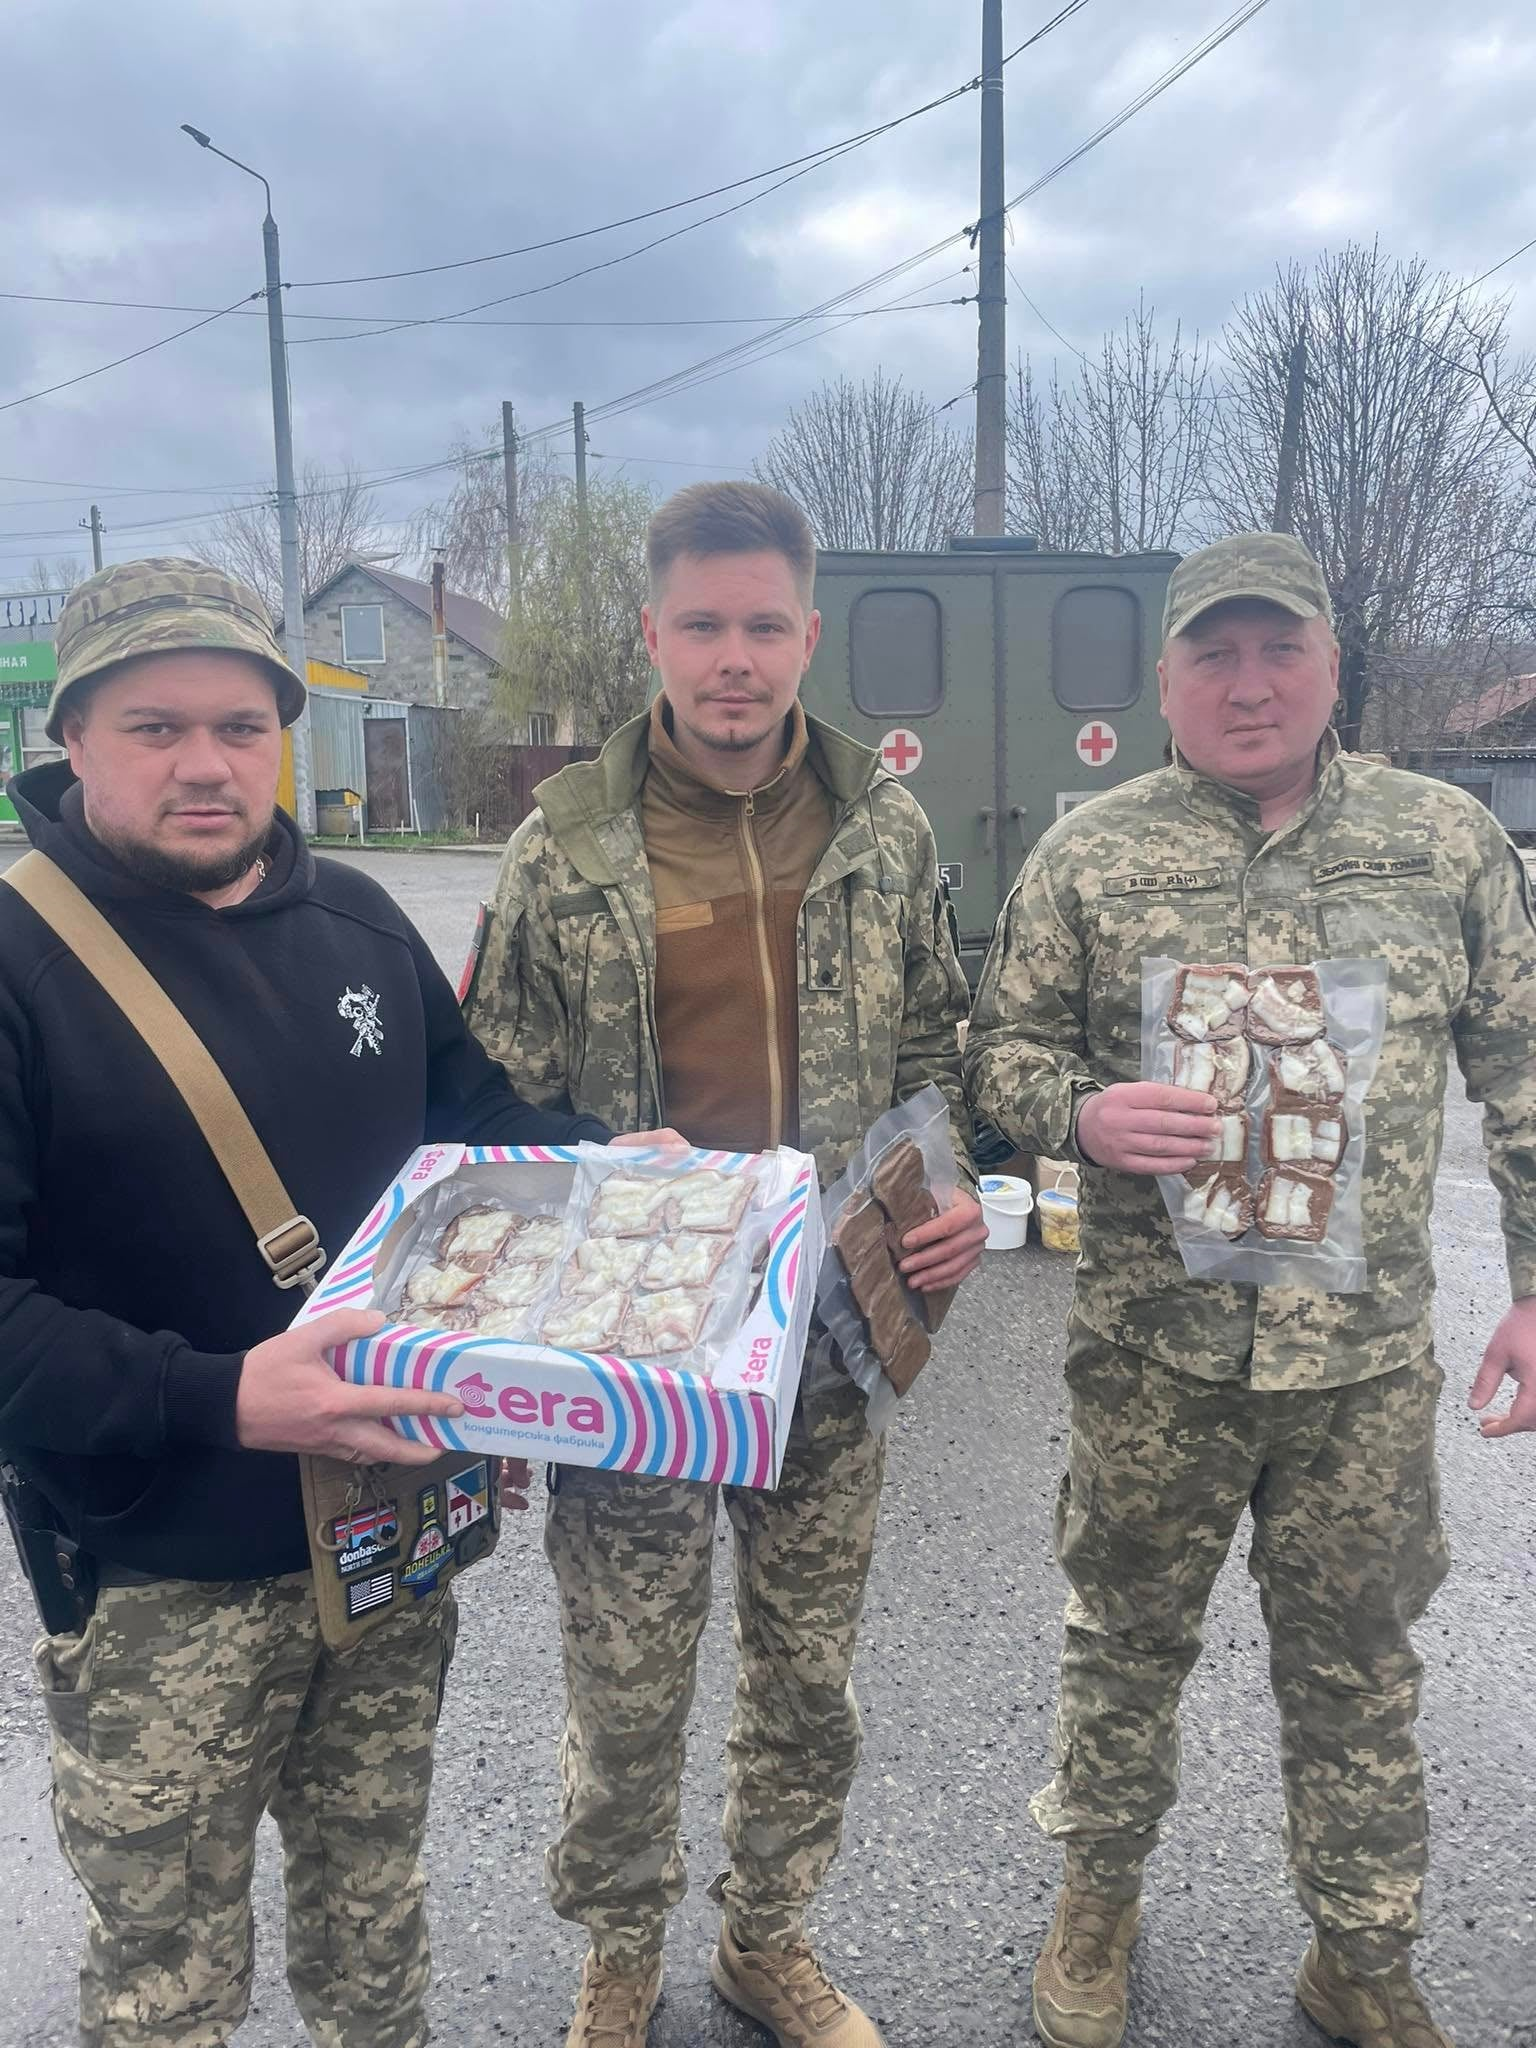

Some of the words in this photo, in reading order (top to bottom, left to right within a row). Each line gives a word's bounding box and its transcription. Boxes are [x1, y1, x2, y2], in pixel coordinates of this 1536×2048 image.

[411, 1150, 446, 1180] tera
[740, 1337, 773, 1383] tera
[454, 1372, 605, 1434] tera
[464, 1422, 550, 1443] кондитерська
[554, 1434, 605, 1450] фабрика
[405, 1543, 453, 1577] ДОНЕЦЬКА
